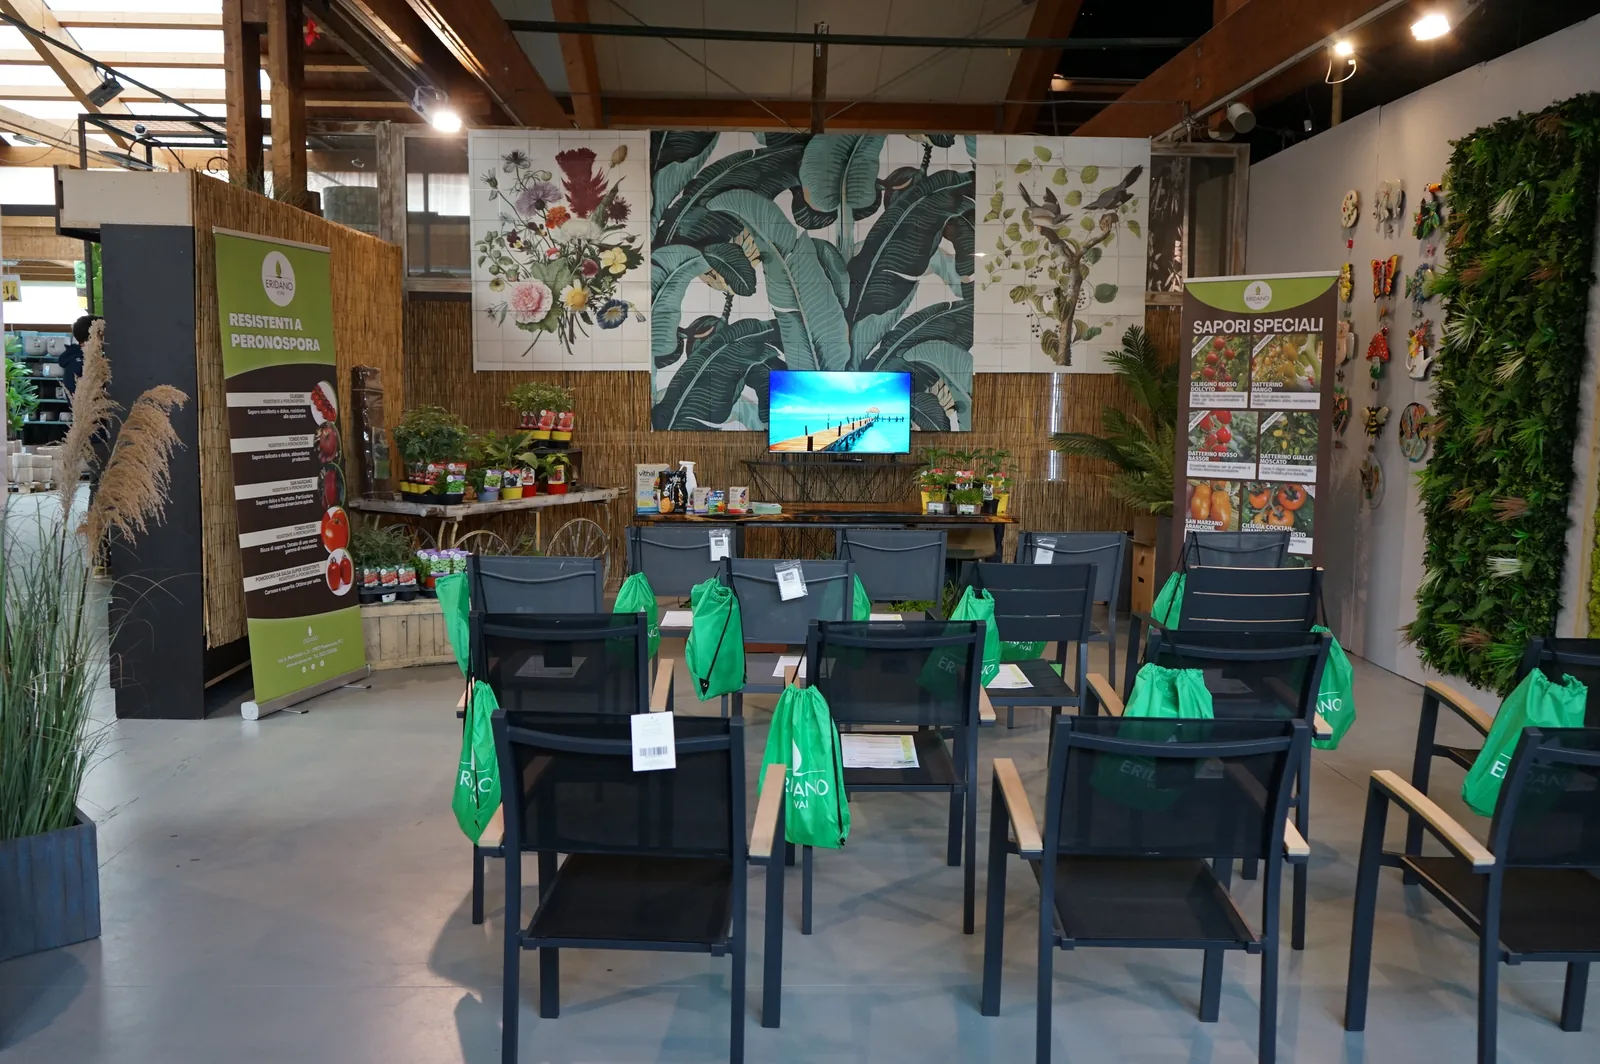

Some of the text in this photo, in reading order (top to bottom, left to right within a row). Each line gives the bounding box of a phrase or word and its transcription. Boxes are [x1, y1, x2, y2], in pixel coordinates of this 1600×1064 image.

[265, 279, 293, 291] ERIDANO
[229, 312, 303, 331] RESISTENTI A
[1193, 317, 1324, 334] SAPORI SPECIALI
[231, 333, 321, 352] PERONOSPORA
[1198, 519, 1224, 527] MARZANO
